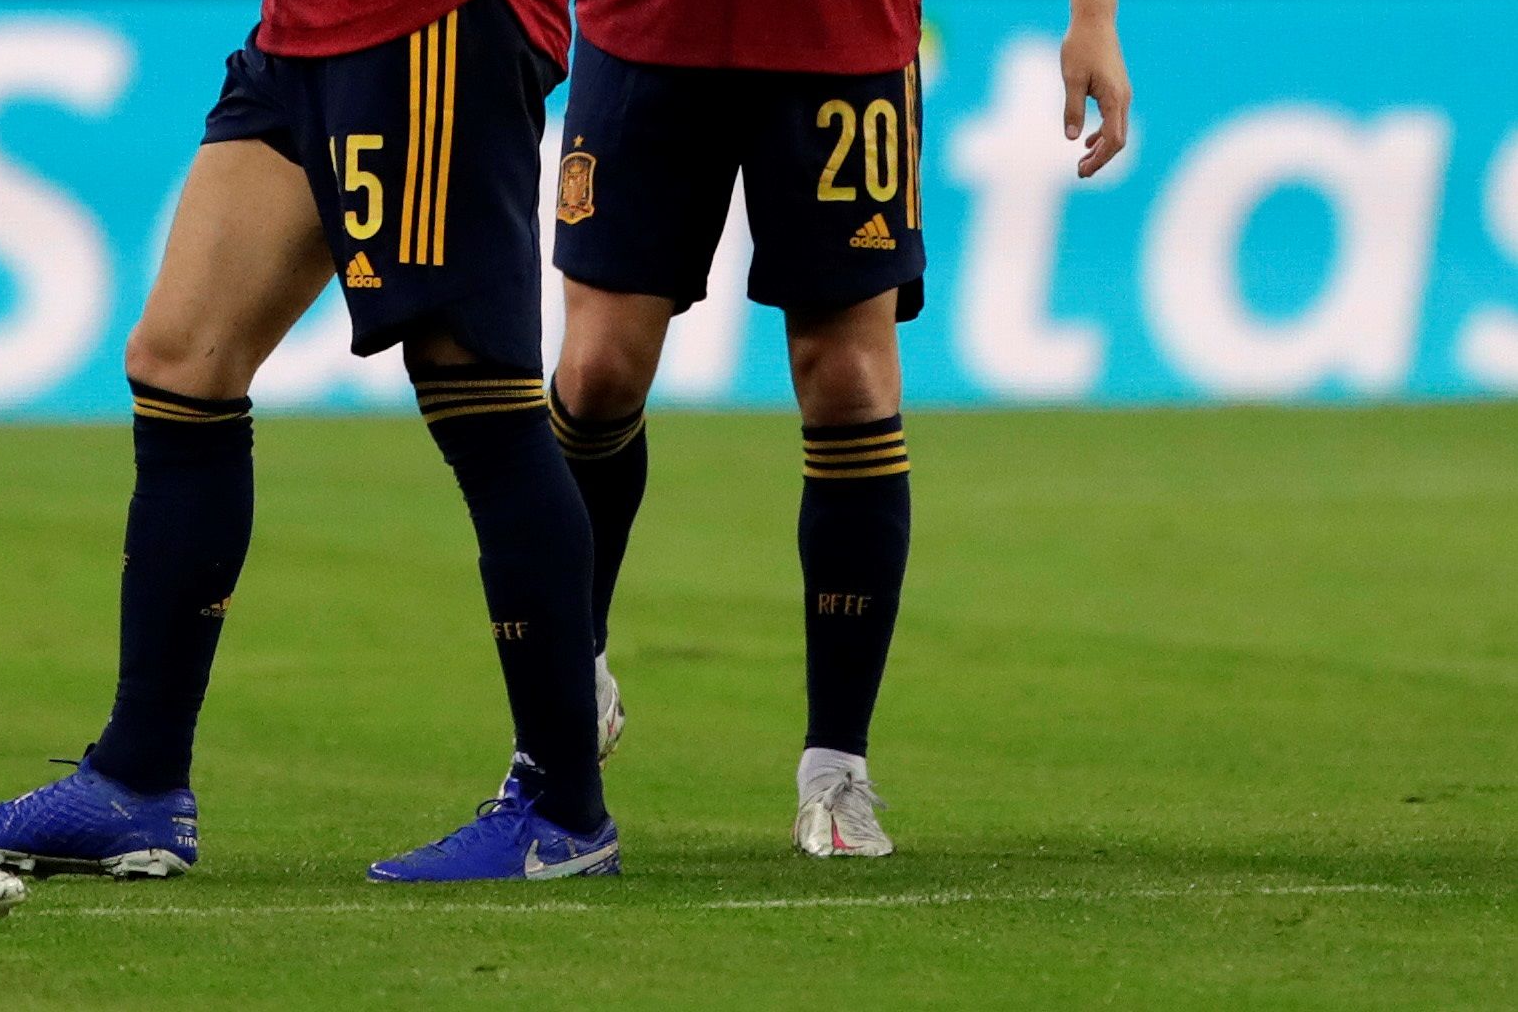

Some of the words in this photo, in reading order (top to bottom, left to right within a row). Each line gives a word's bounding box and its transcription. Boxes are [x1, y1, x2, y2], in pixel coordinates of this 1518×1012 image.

[816, 98, 898, 203] 20
[849, 236, 897, 251] adidas
[817, 593, 872, 616] RFEF
